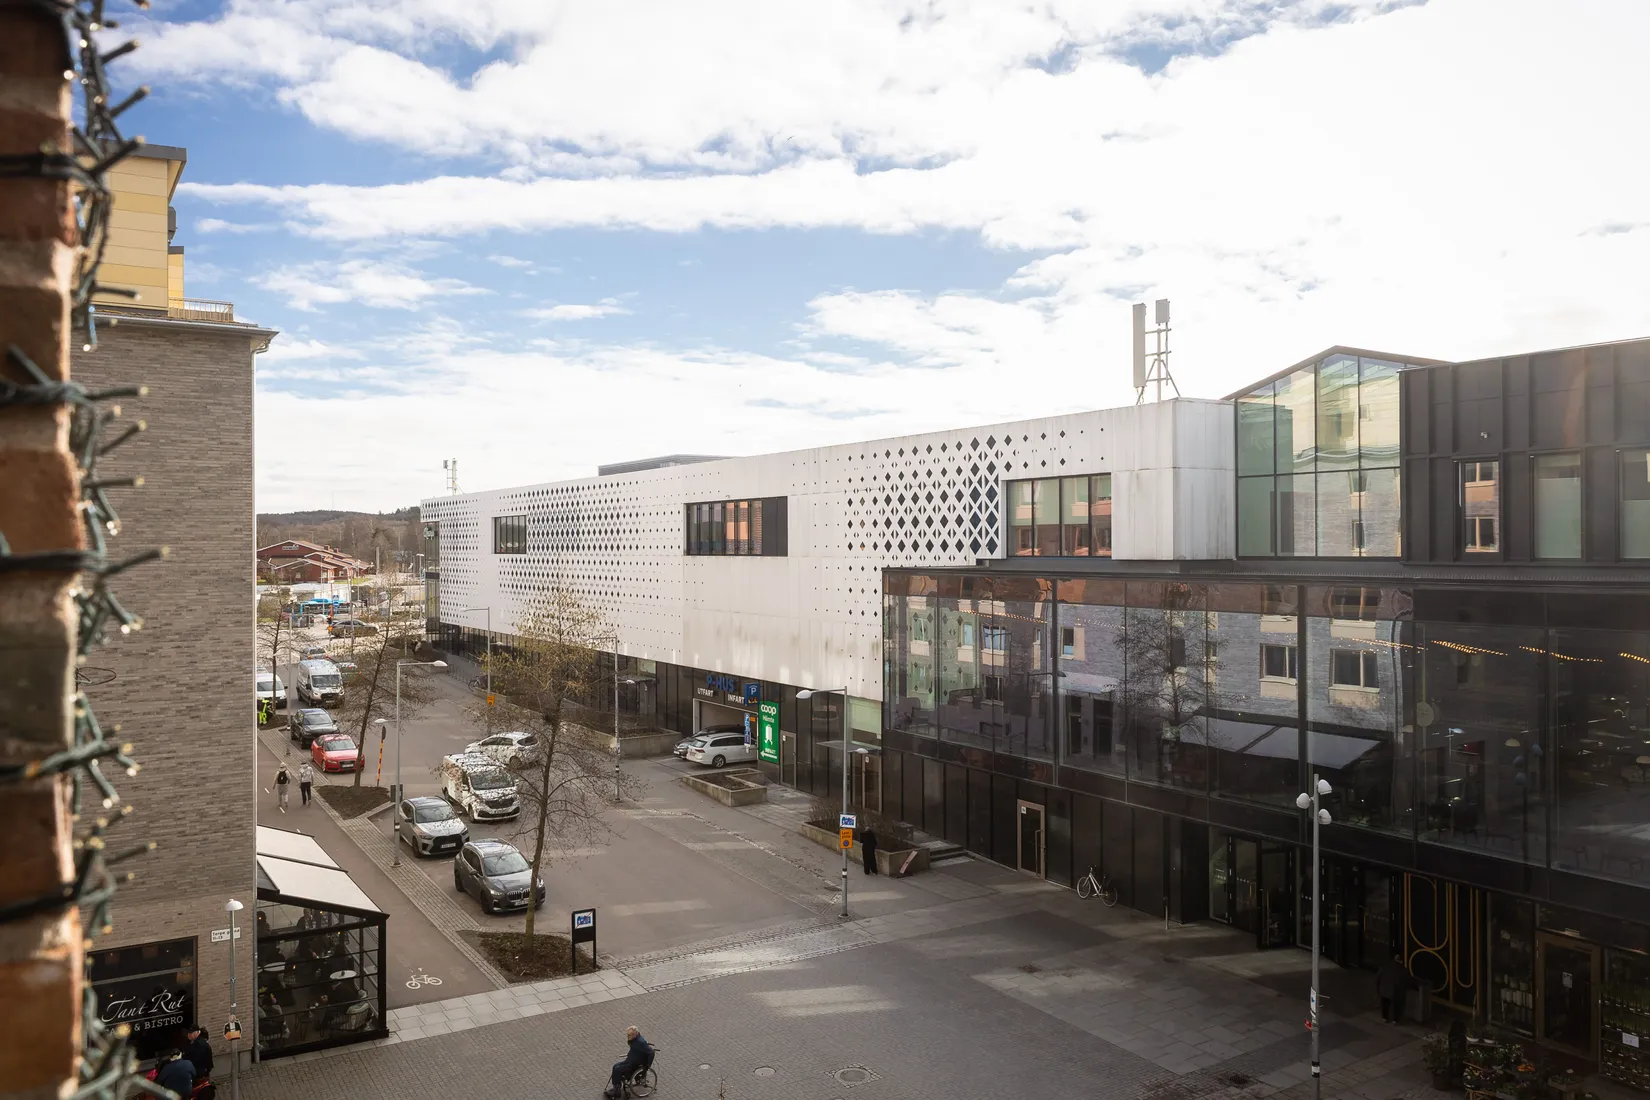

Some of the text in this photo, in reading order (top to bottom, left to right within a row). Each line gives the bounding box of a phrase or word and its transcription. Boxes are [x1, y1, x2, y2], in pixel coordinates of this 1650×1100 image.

[706, 674, 734, 693] P-HUS
[697, 687, 713, 697] UTFART
[728, 694, 744, 704] INFART
[101, 989, 185, 1022] Tant Rut
[134, 1023, 141, 1031] &
[144, 1015, 184, 1030] BISTRO
